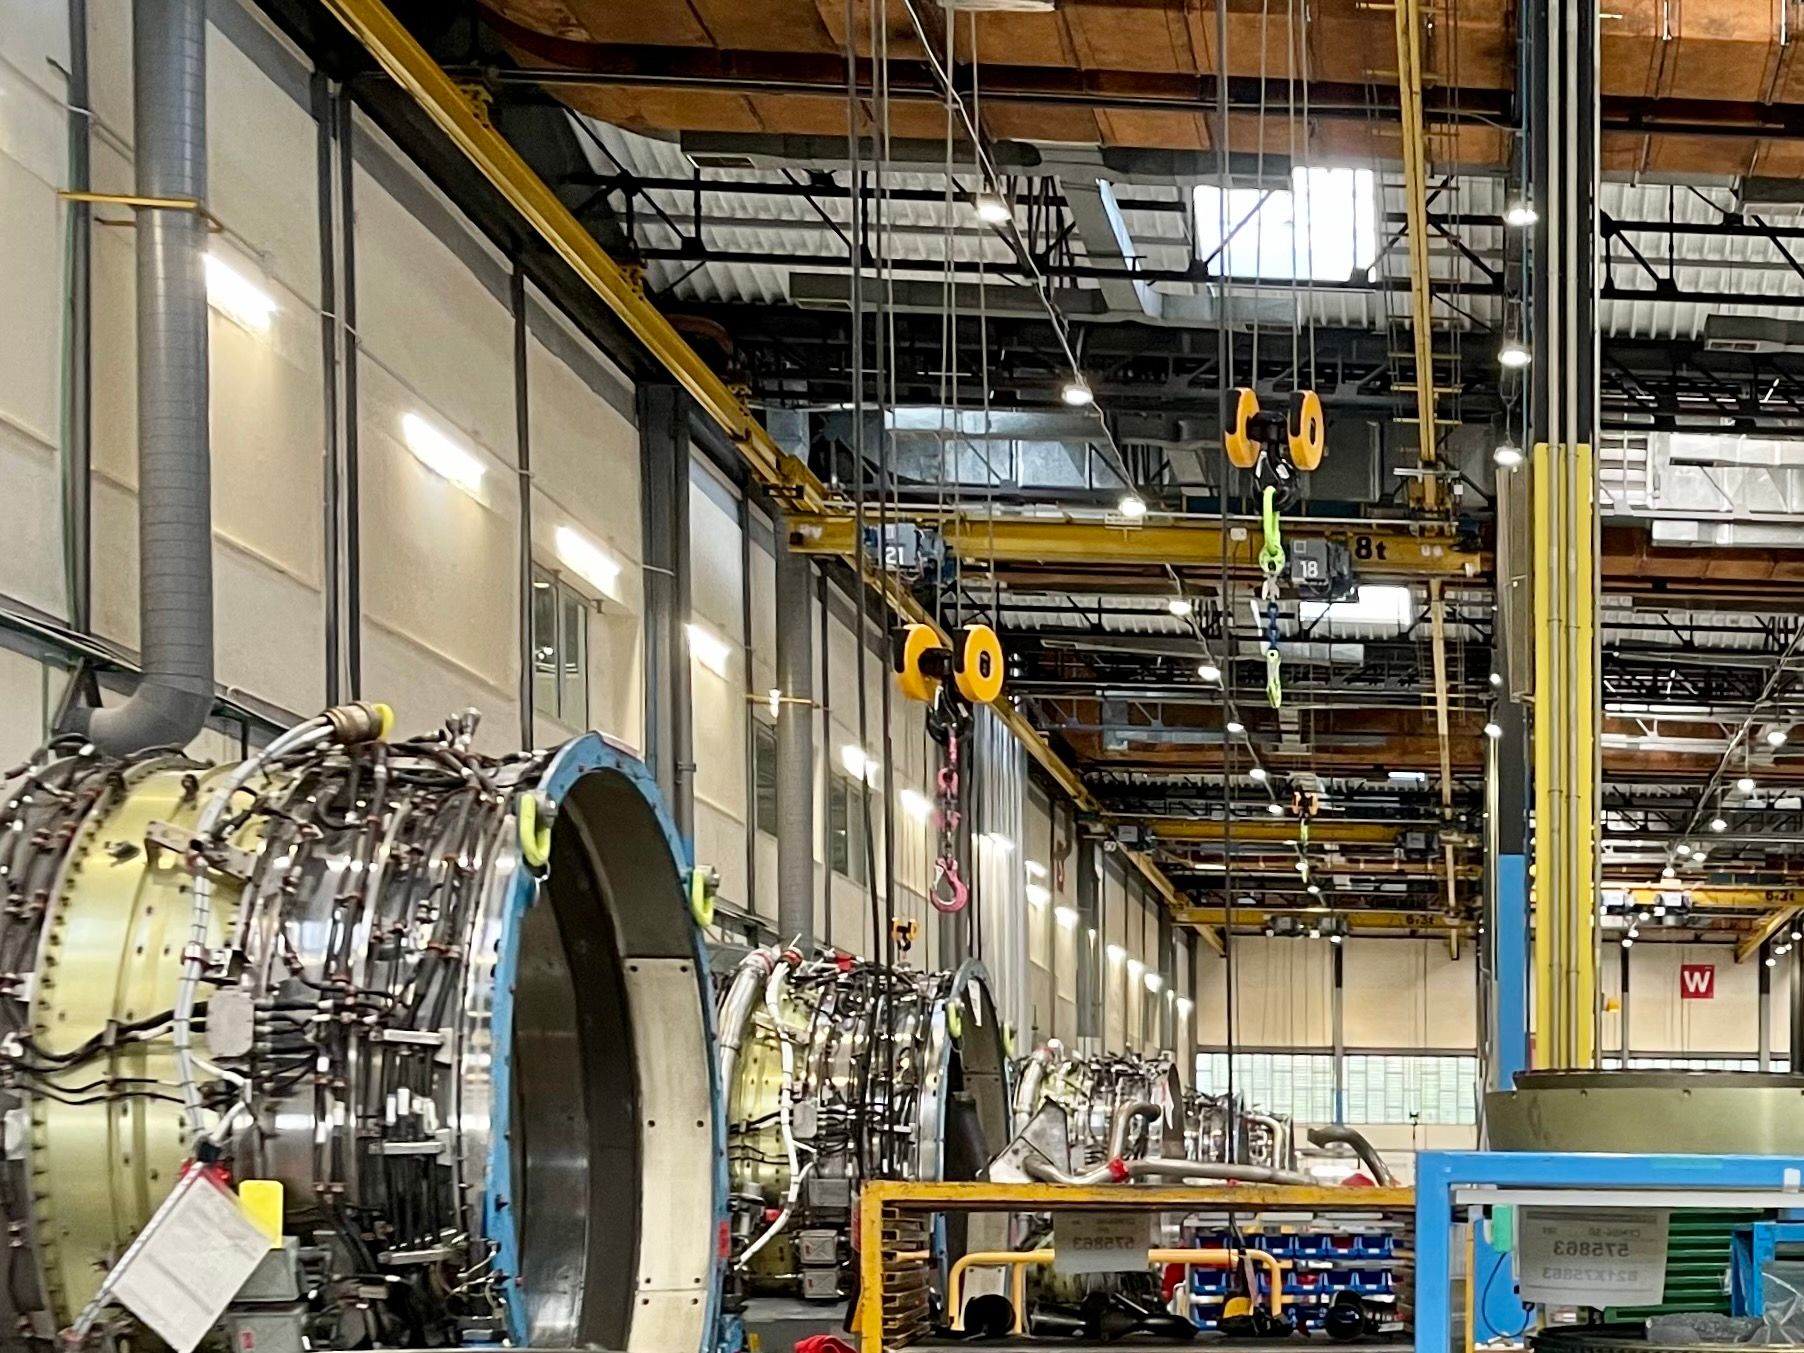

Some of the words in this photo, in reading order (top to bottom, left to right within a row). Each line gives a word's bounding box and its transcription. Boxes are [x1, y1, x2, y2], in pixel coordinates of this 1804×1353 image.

[885, 547, 904, 564] 21
[1300, 560, 1318, 578] 18
[1684, 971, 1711, 993] W
